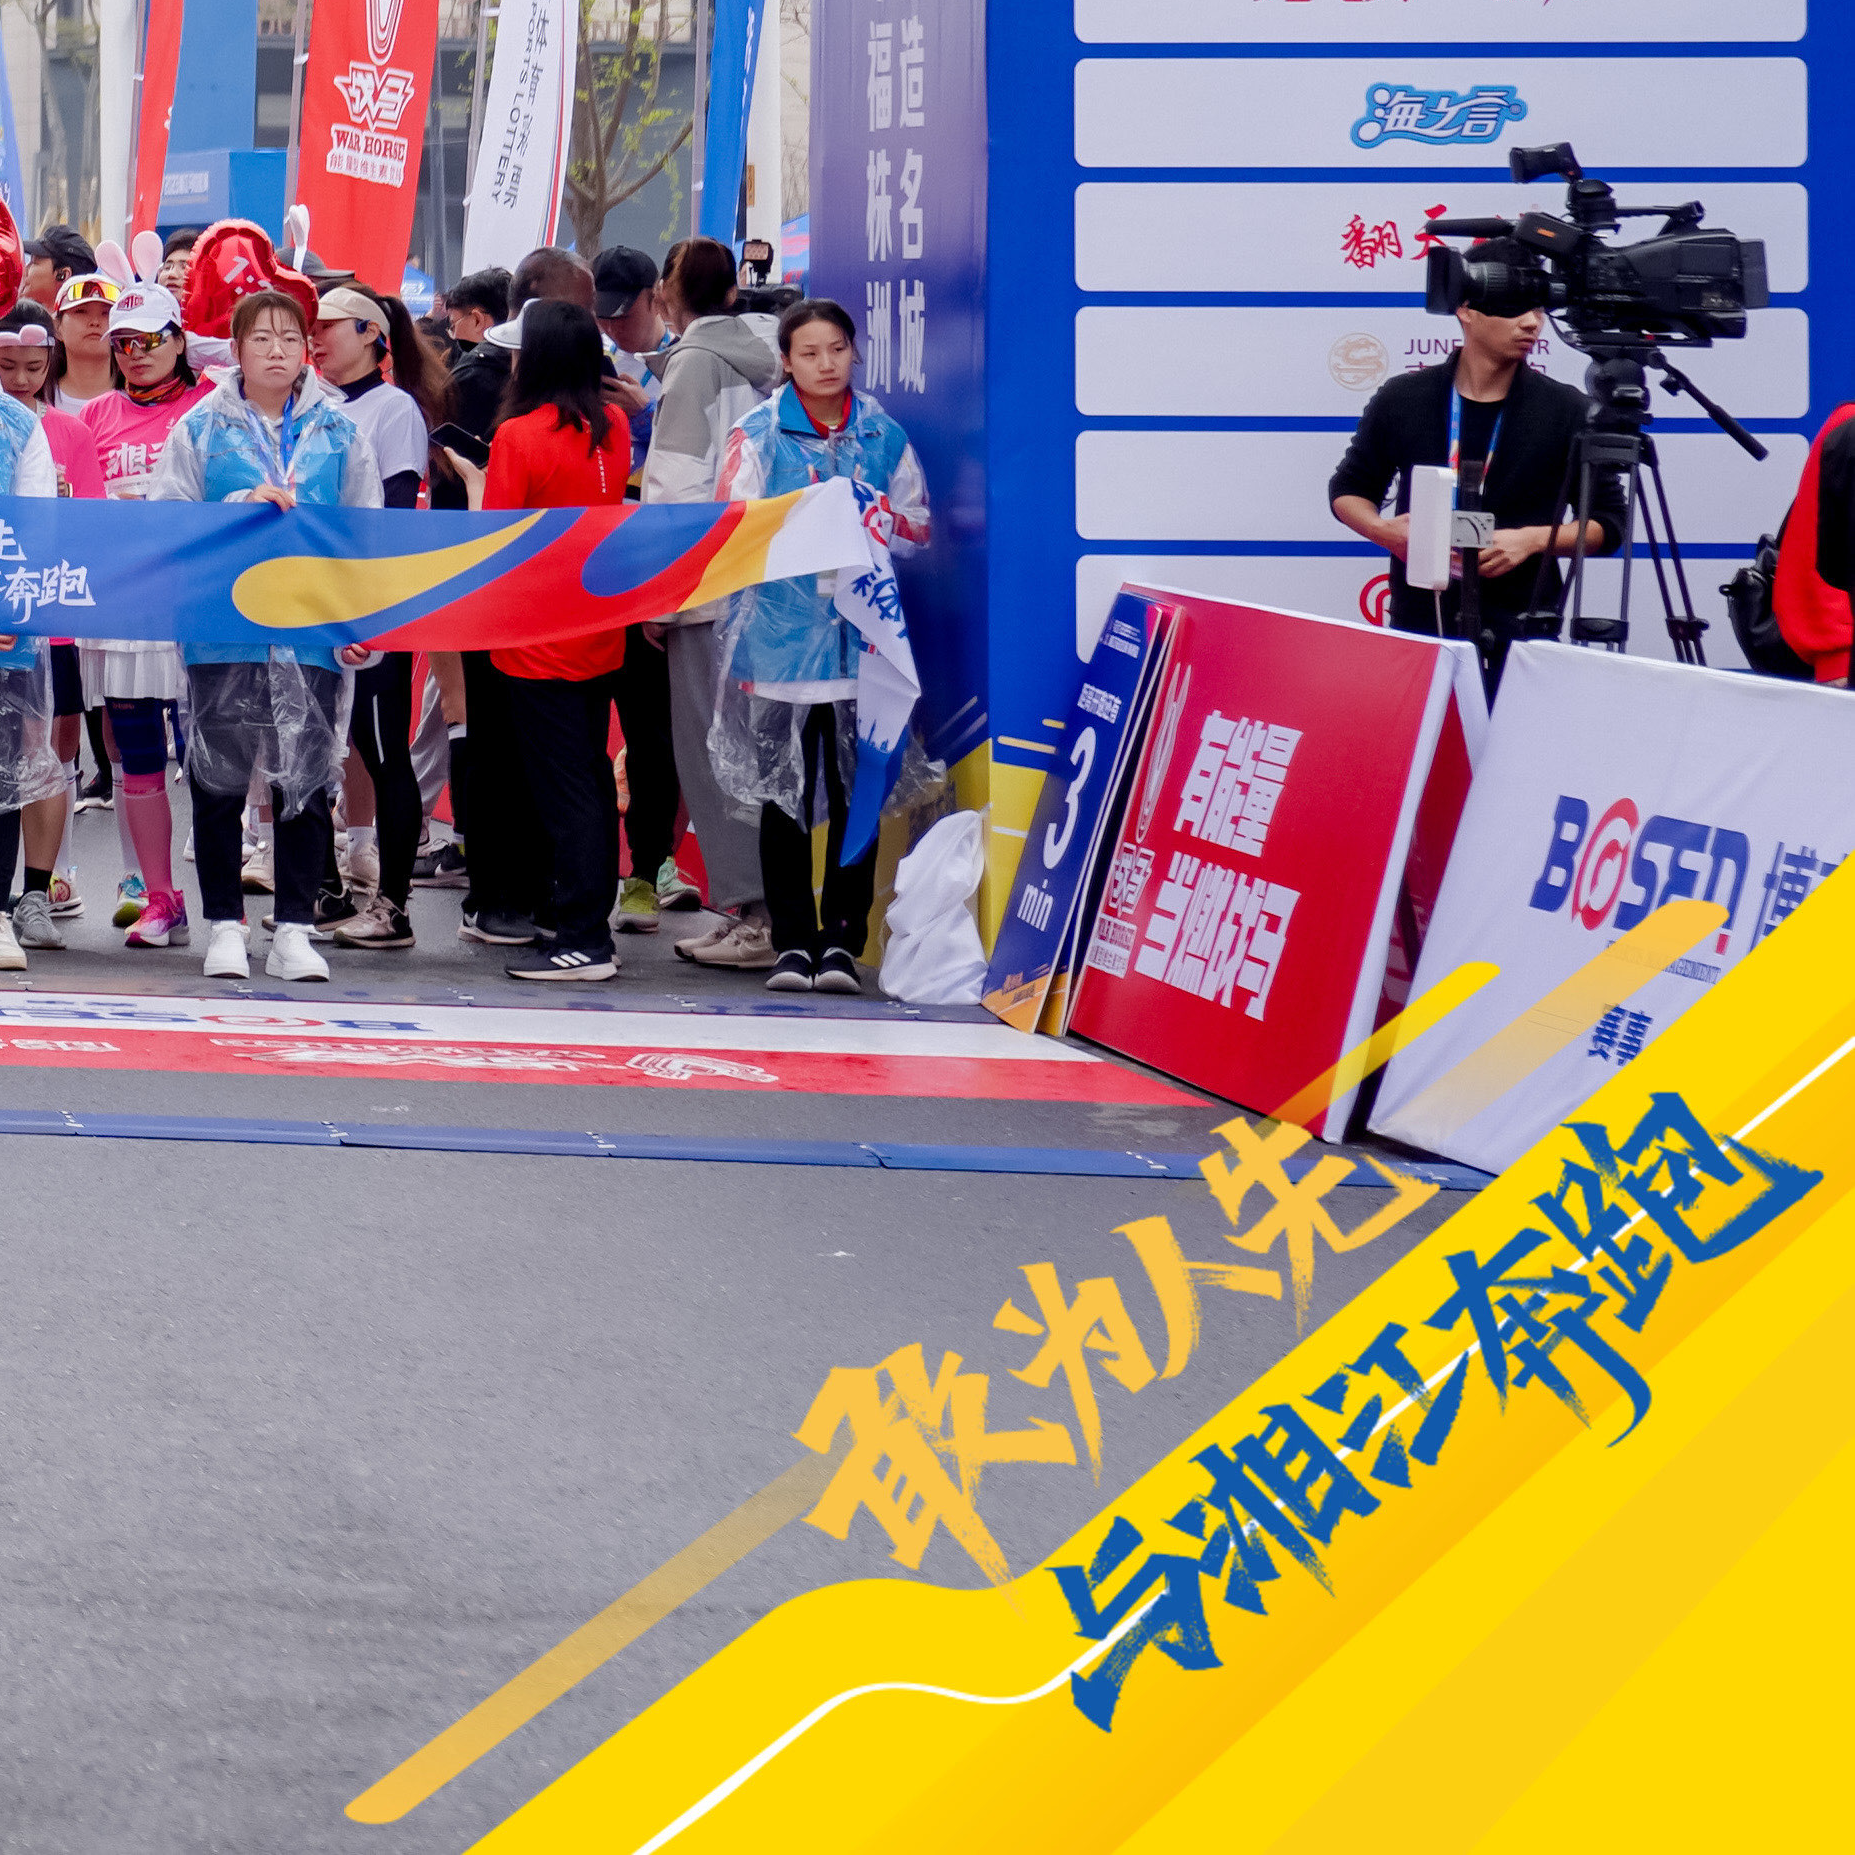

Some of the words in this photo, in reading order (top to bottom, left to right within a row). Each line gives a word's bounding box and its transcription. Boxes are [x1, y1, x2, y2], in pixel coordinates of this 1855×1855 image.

[335, 129, 361, 152] WAR
[364, 135, 406, 161] HORSE
[490, 92, 525, 206] LOTTERY
[1042, 726, 1097, 870] 3
[1173, 709, 1304, 858] 有能量
[1016, 878, 1055, 933] min
[1134, 851, 1302, 1023] 当燃战马
